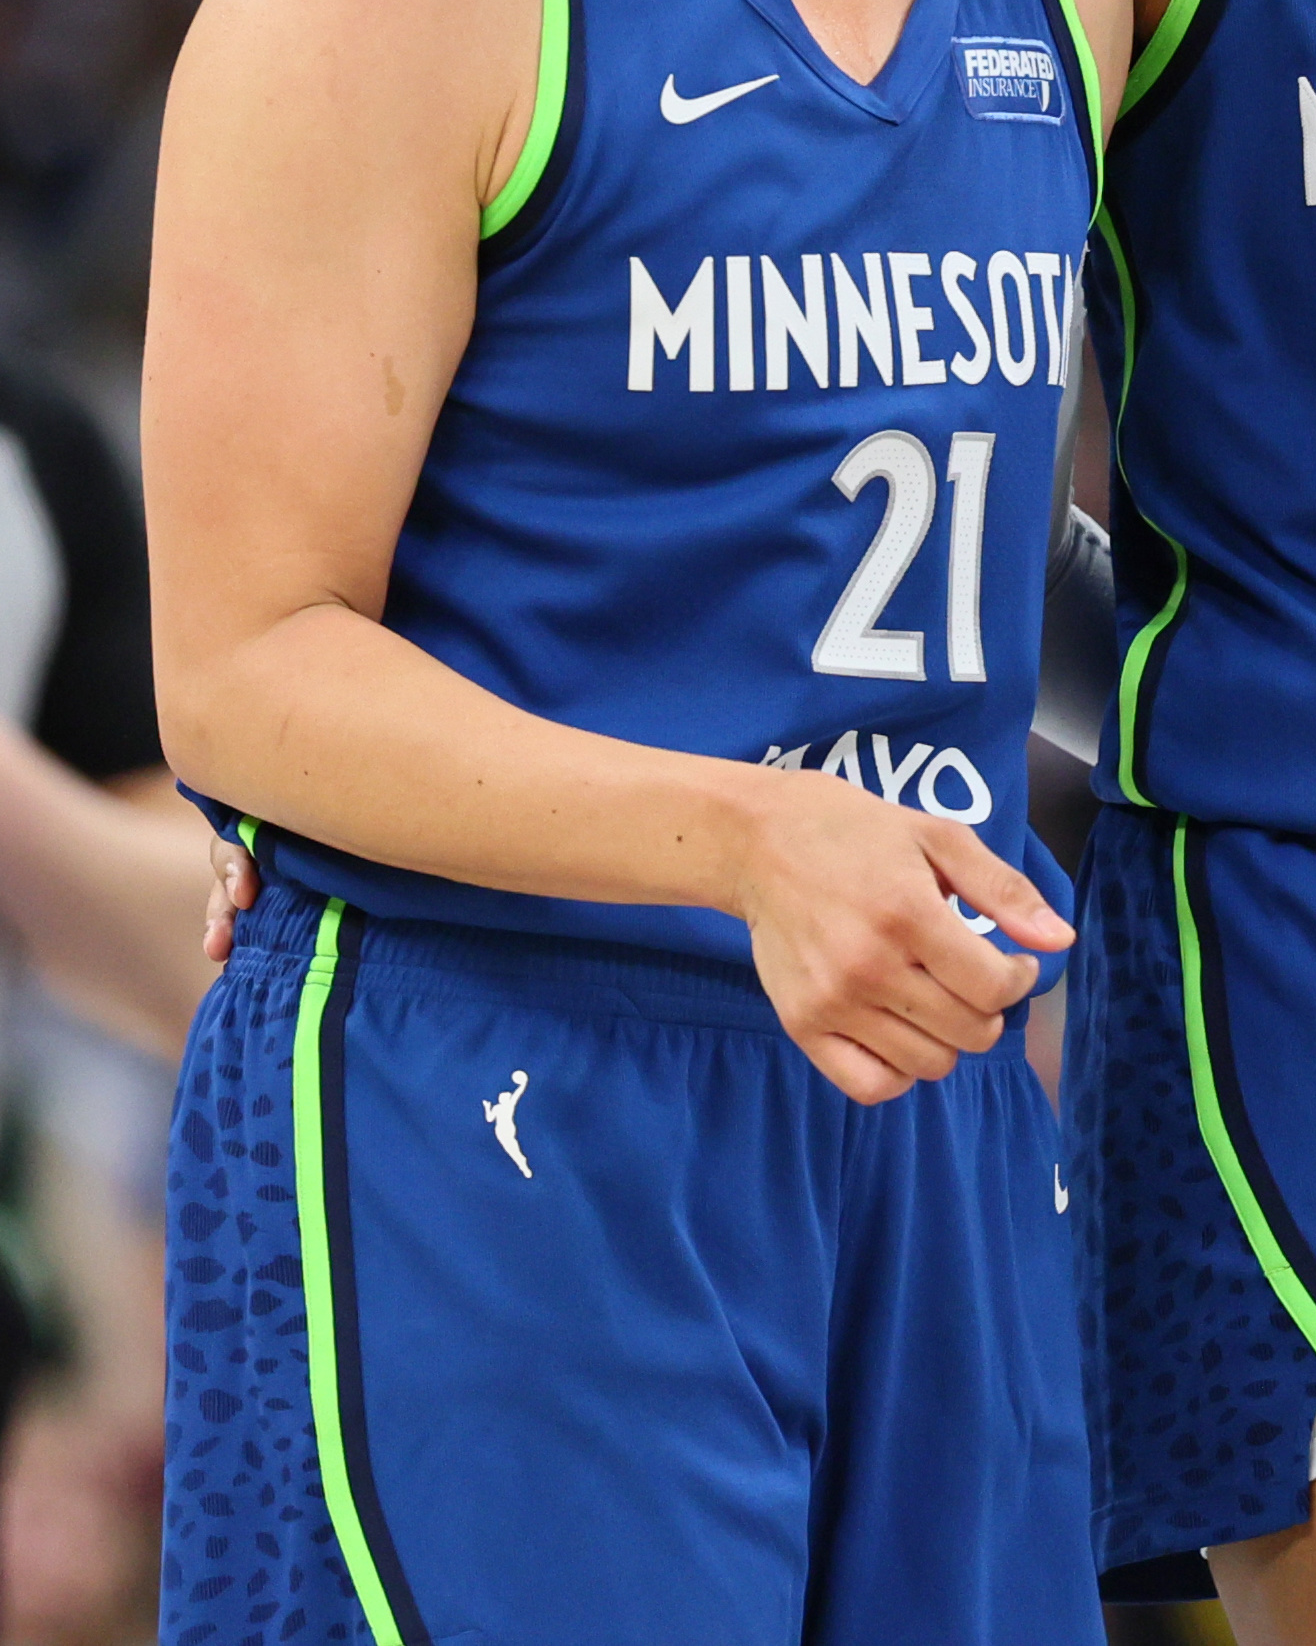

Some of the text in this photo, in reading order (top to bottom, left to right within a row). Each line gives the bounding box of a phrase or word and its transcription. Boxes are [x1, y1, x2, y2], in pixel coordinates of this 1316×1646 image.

[964, 48, 1055, 81] FEDERATED
[967, 77, 1039, 98] INSURANCE
[811, 429, 996, 683] 21
[757, 730, 993, 825] AYO
